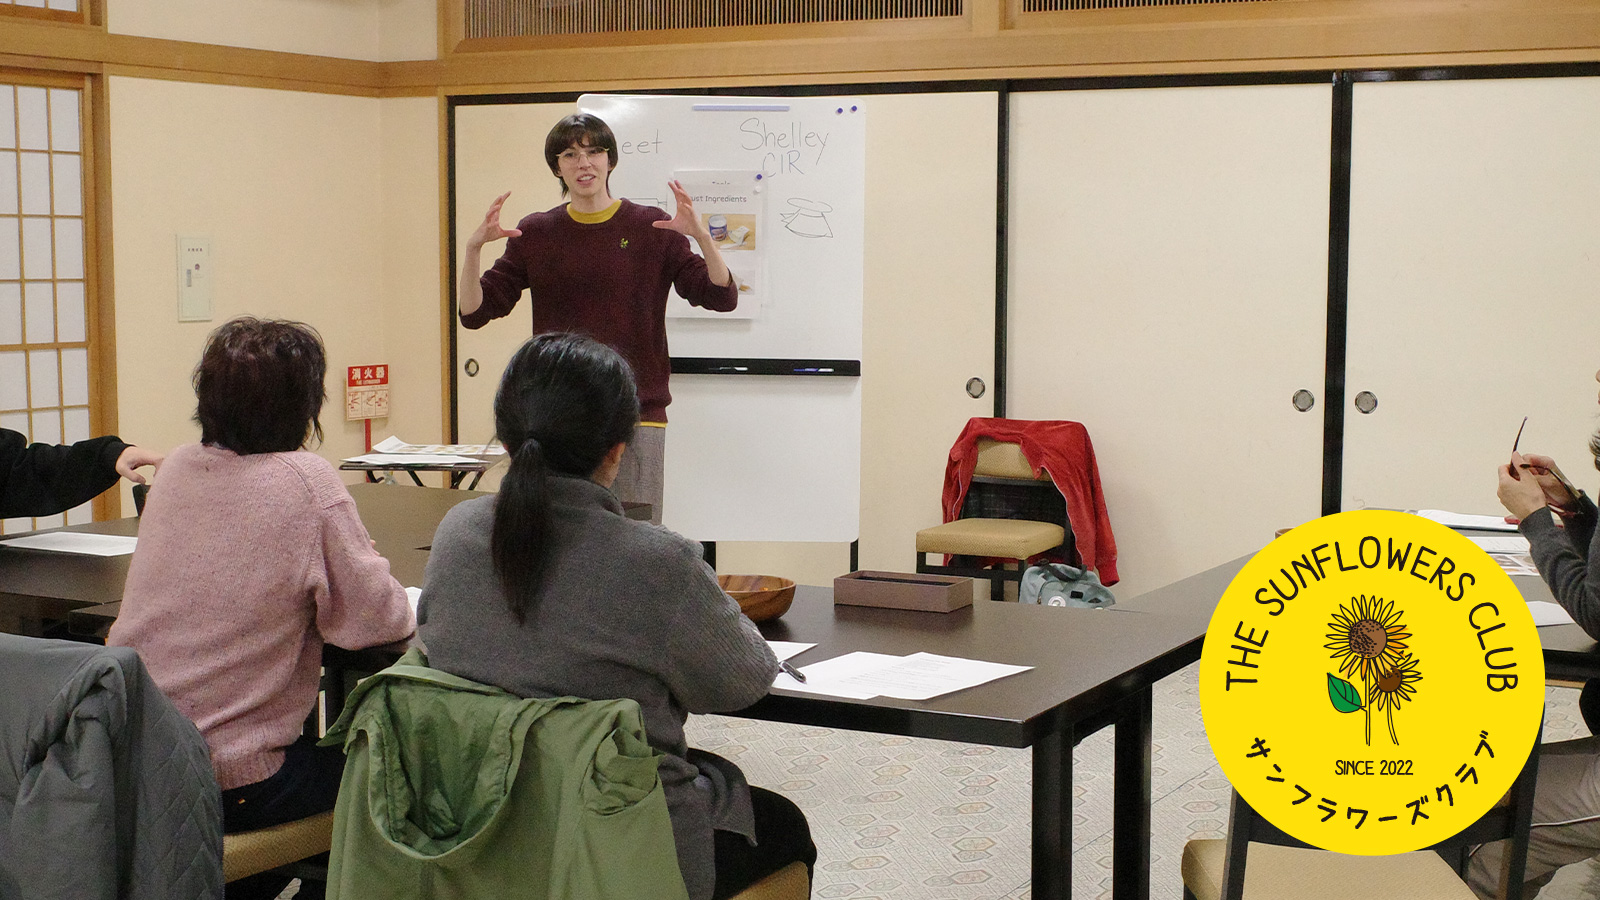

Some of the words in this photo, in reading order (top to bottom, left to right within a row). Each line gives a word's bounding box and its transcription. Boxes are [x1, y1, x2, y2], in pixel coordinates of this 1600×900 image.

[621, 129, 662, 154] eet
[740, 117, 829, 165] Shelley
[762, 149, 804, 177] CIR
[705, 195, 747, 204] Ingredients
